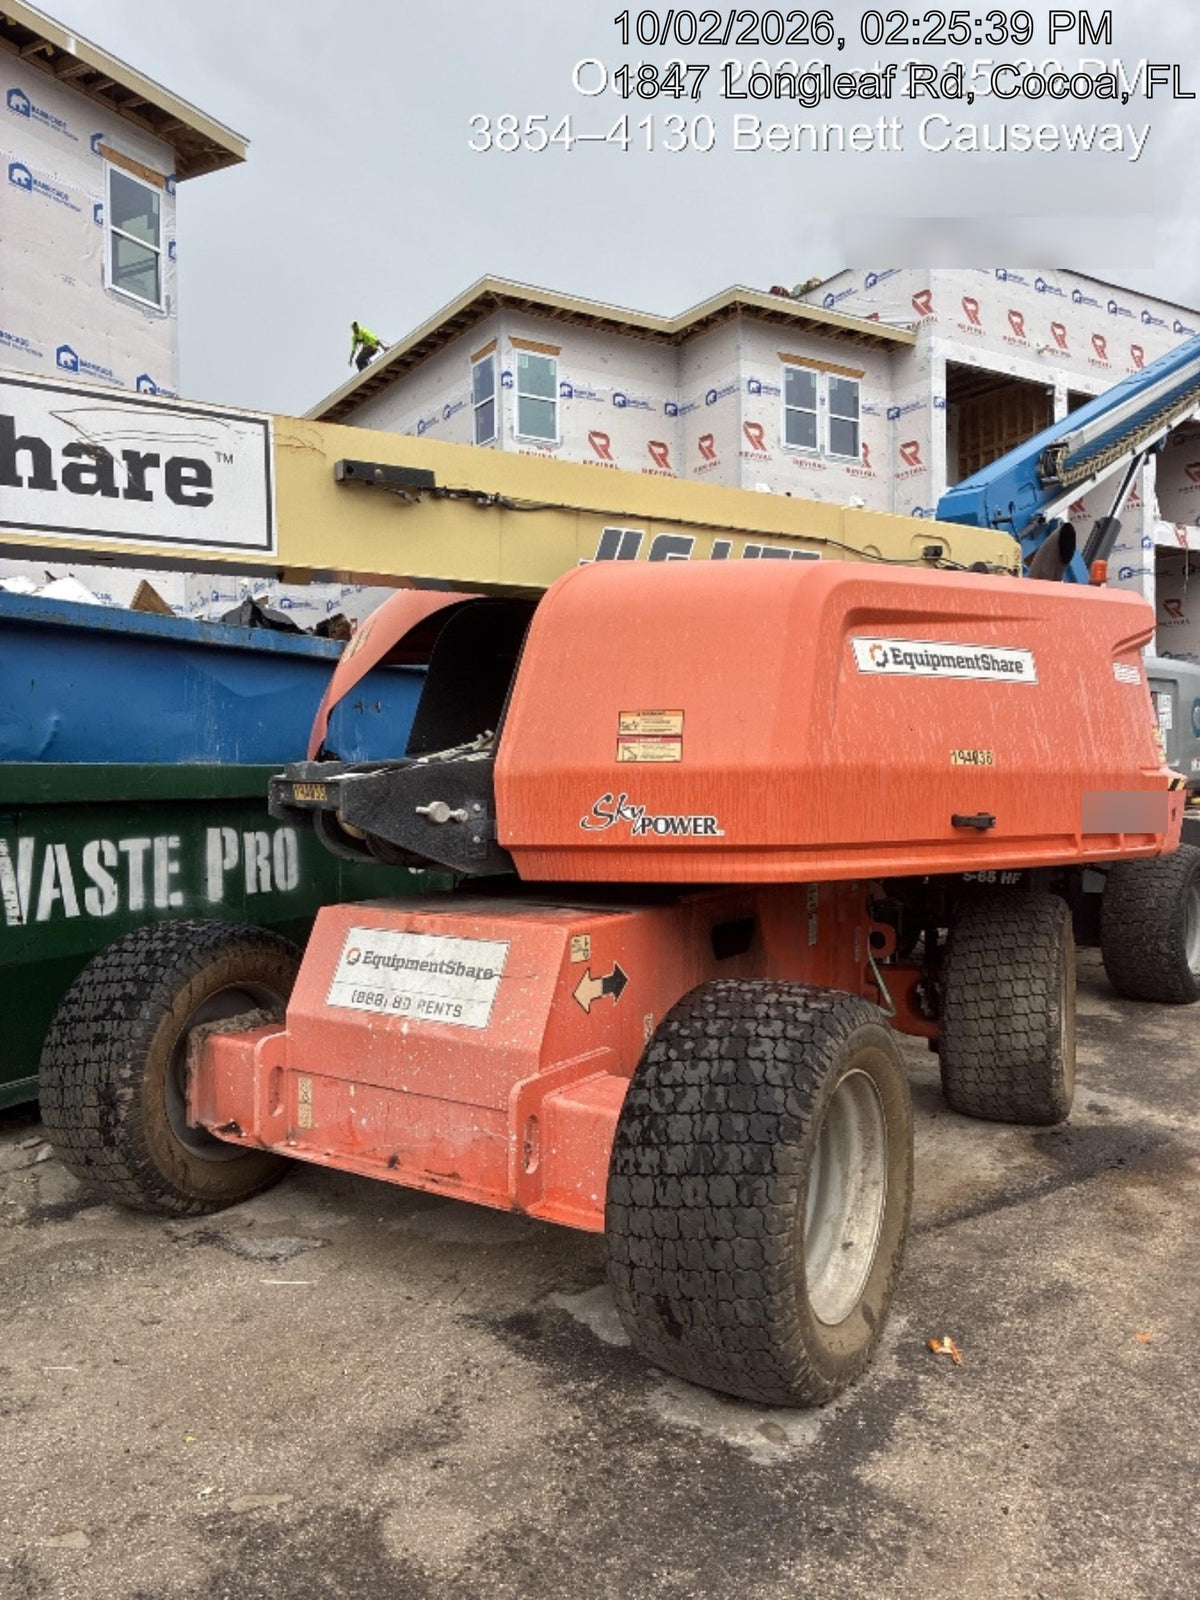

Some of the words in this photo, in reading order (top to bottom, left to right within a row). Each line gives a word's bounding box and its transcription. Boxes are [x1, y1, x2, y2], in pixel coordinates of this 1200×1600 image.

[0, 414, 213, 508] hare
[890, 647, 1024, 675] EquipmentShare
[206, 826, 299, 902] PRO
[362, 950, 495, 981] EquipmentShare
